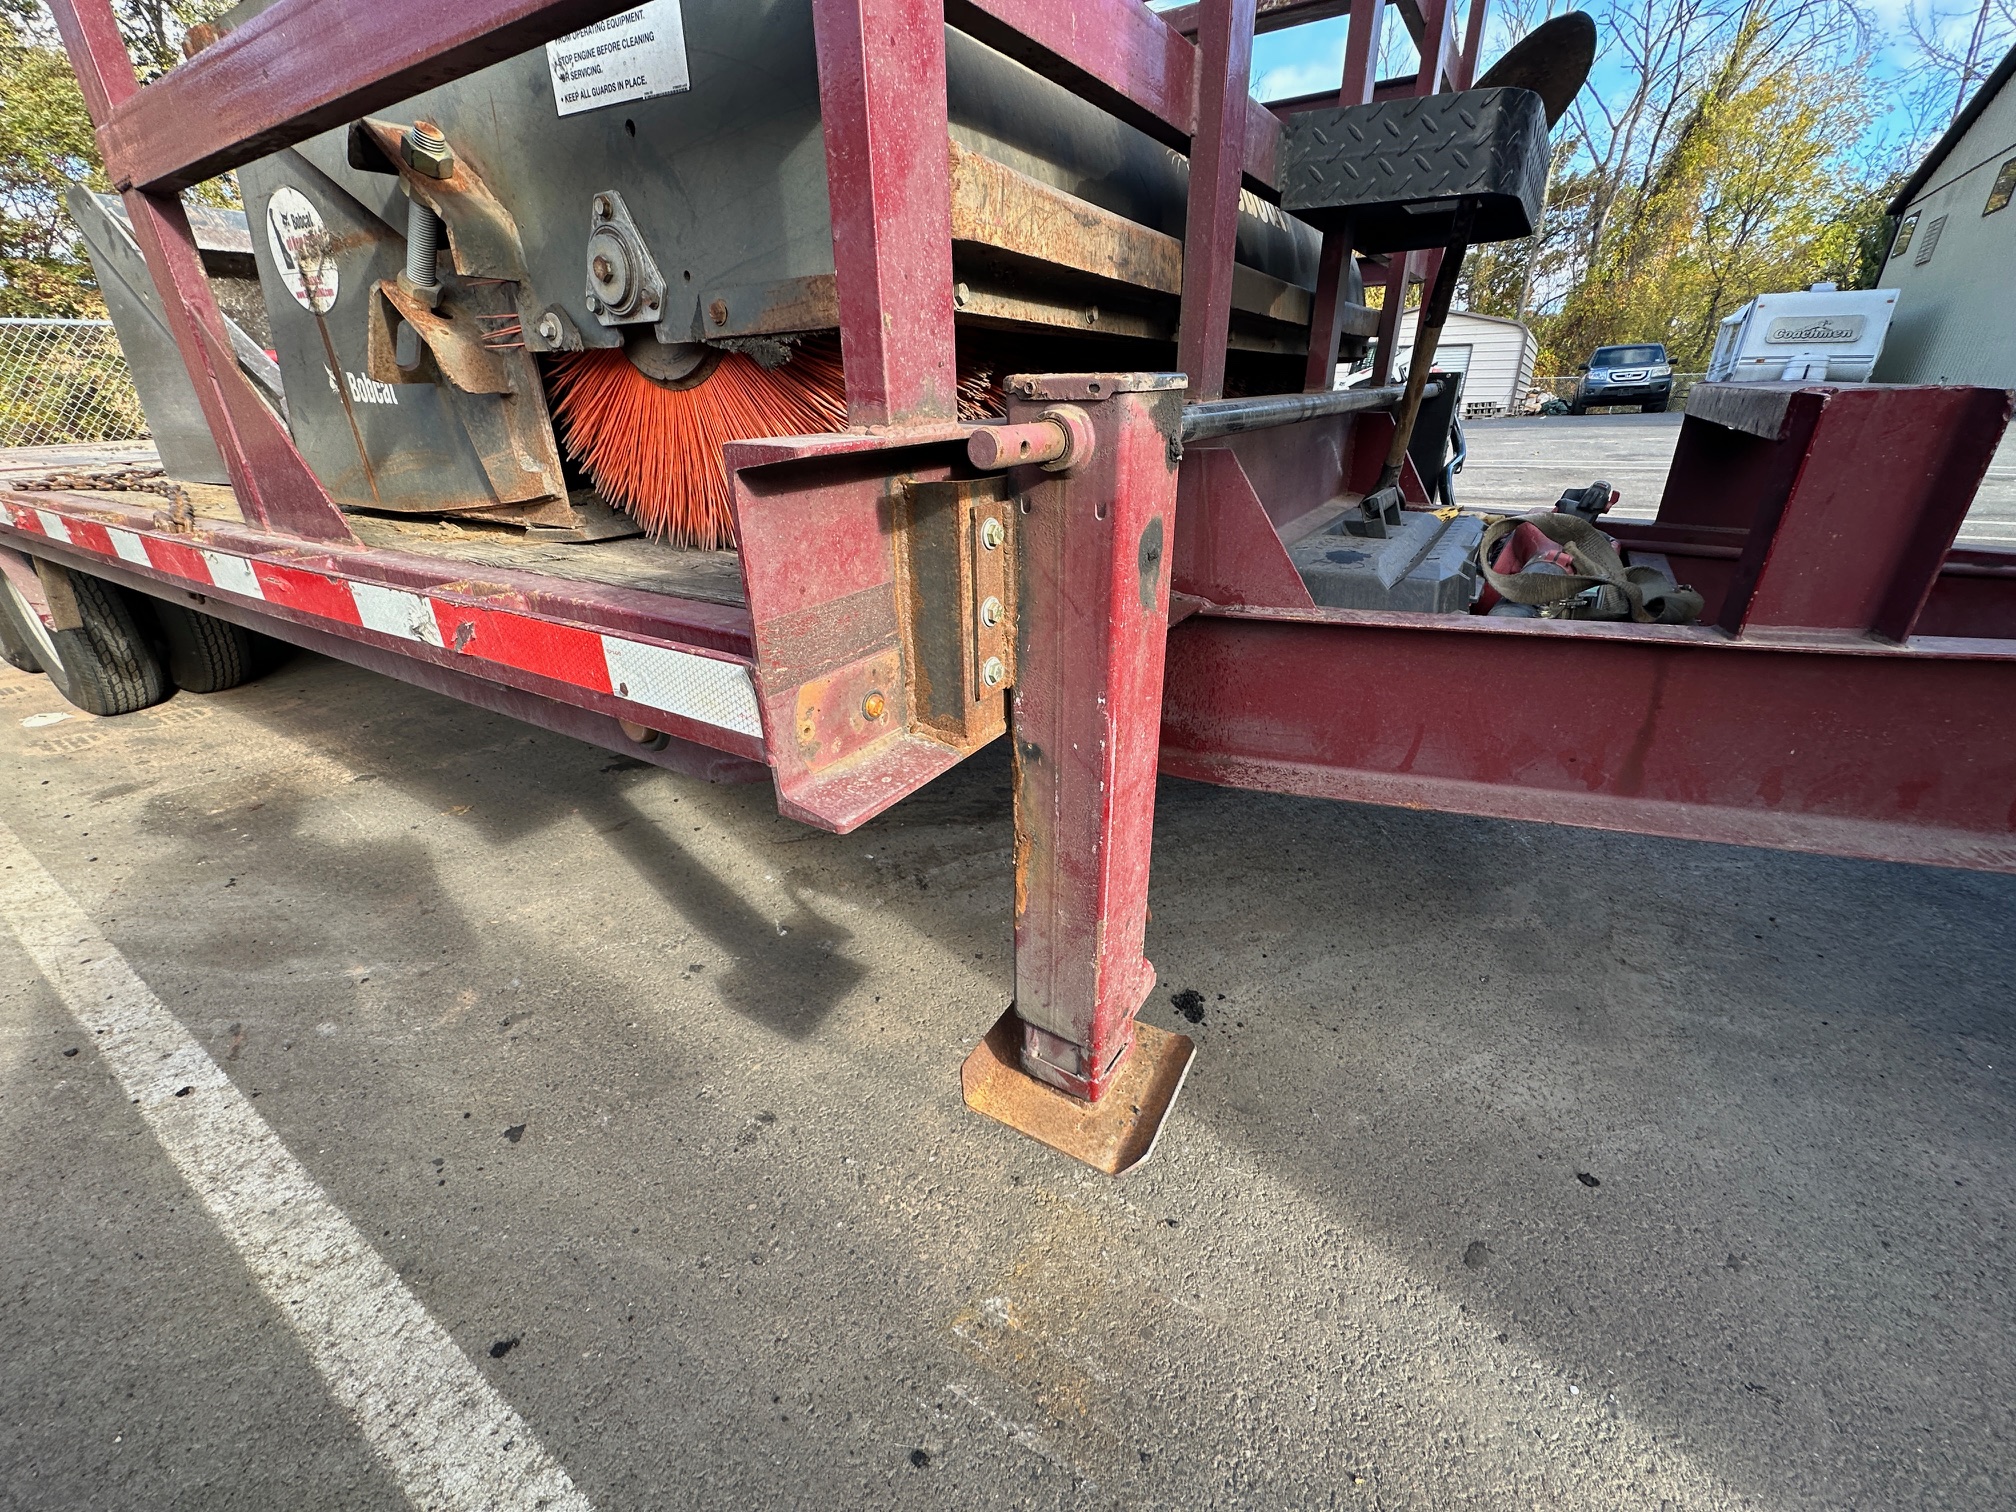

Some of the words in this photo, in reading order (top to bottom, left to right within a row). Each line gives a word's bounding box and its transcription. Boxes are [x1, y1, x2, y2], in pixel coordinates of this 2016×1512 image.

[606, 9, 646, 30] EQUIPMENT.
[557, 54, 574, 67] STOP
[573, 47, 597, 62] ENGINE
[596, 40, 622, 56] BEFORE
[621, 31, 655, 49] CLEANING
[570, 64, 604, 80] SERVICING.
[564, 91, 580, 103] KEEP
[580, 87, 592, 99] ALL
[591, 82, 617, 97] GUARDS
[616, 80, 624, 91] IN
[624, 75, 648, 89] PLACE.
[290, 211, 315, 230] Bobcat
[1773, 328, 1853, 340] Coachmen
[346, 371, 399, 405] Bobcat
